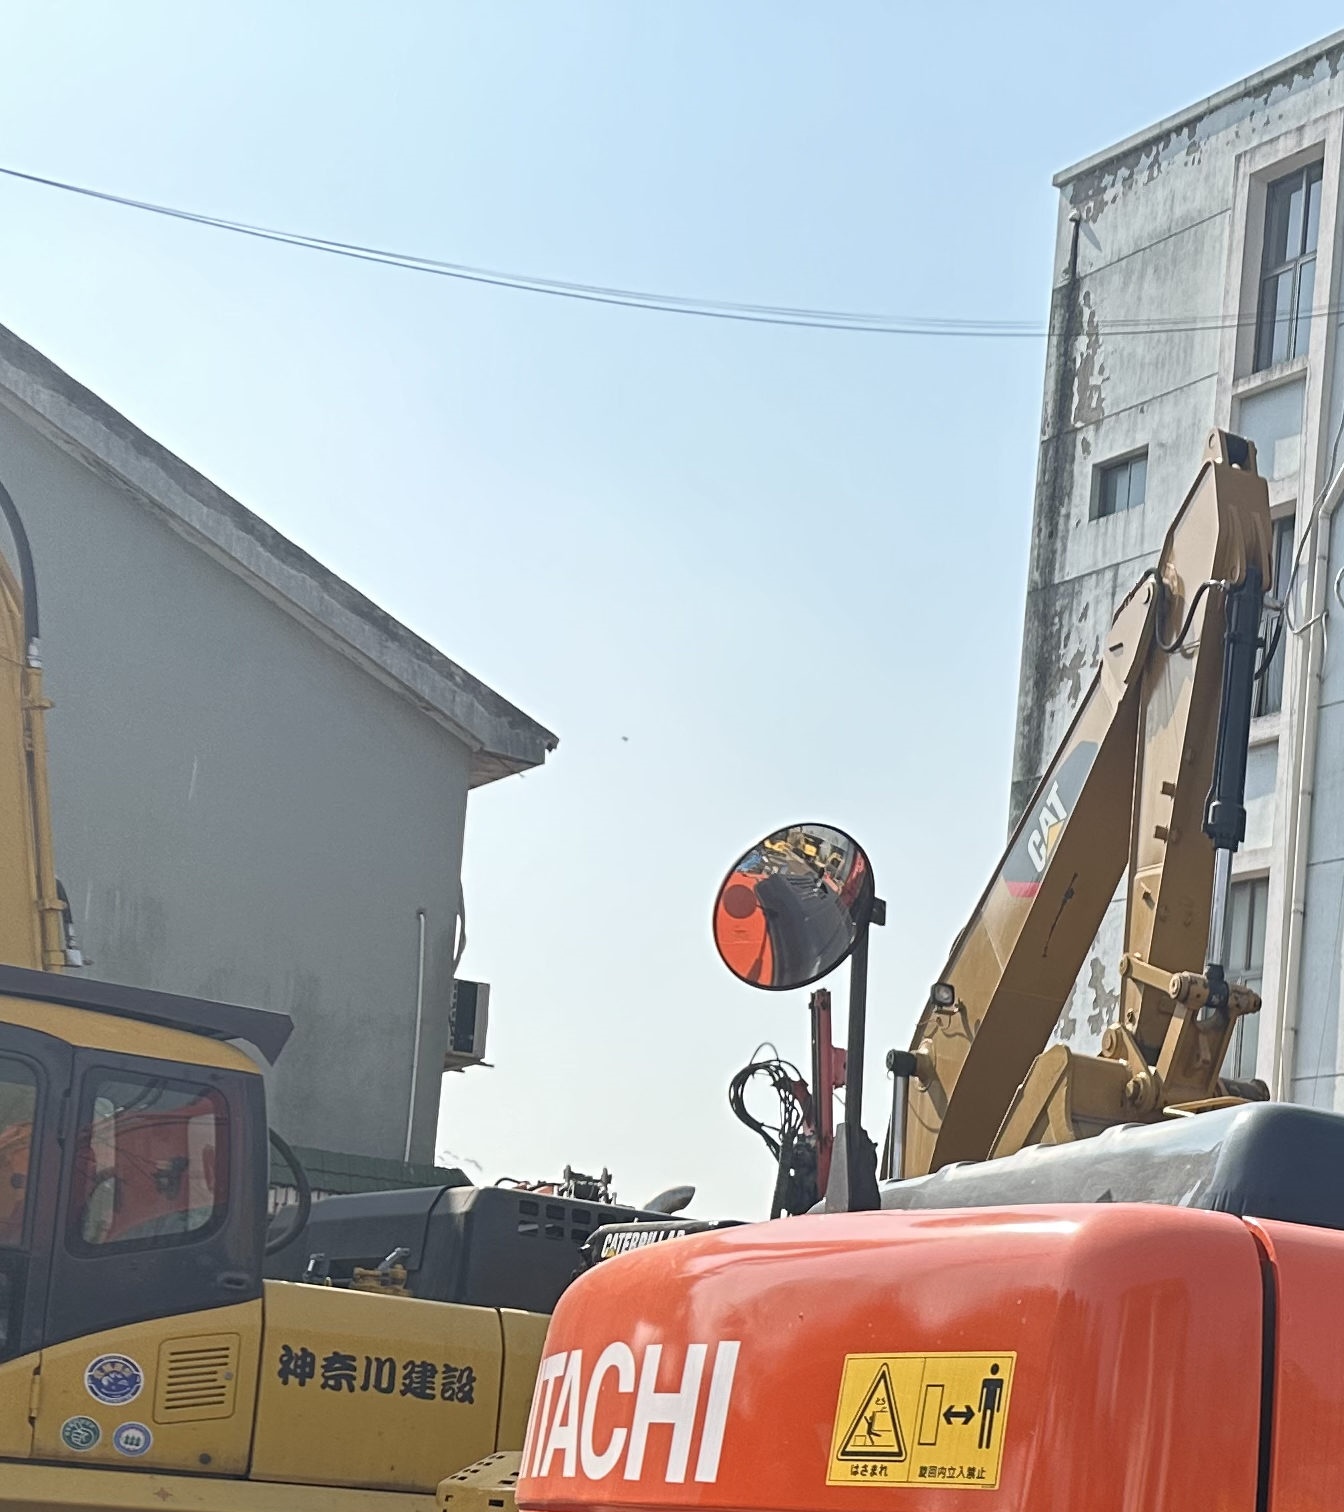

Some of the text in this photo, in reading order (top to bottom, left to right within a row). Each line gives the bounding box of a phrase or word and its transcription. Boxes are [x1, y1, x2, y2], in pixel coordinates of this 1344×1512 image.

[1027, 780, 1068, 873] CAT
[601, 1229, 686, 1258] CATERPI
[277, 1344, 477, 1405] 神奈川建設
[517, 1340, 742, 1484] ITACHI
[850, 1463, 889, 1477] はさまれ
